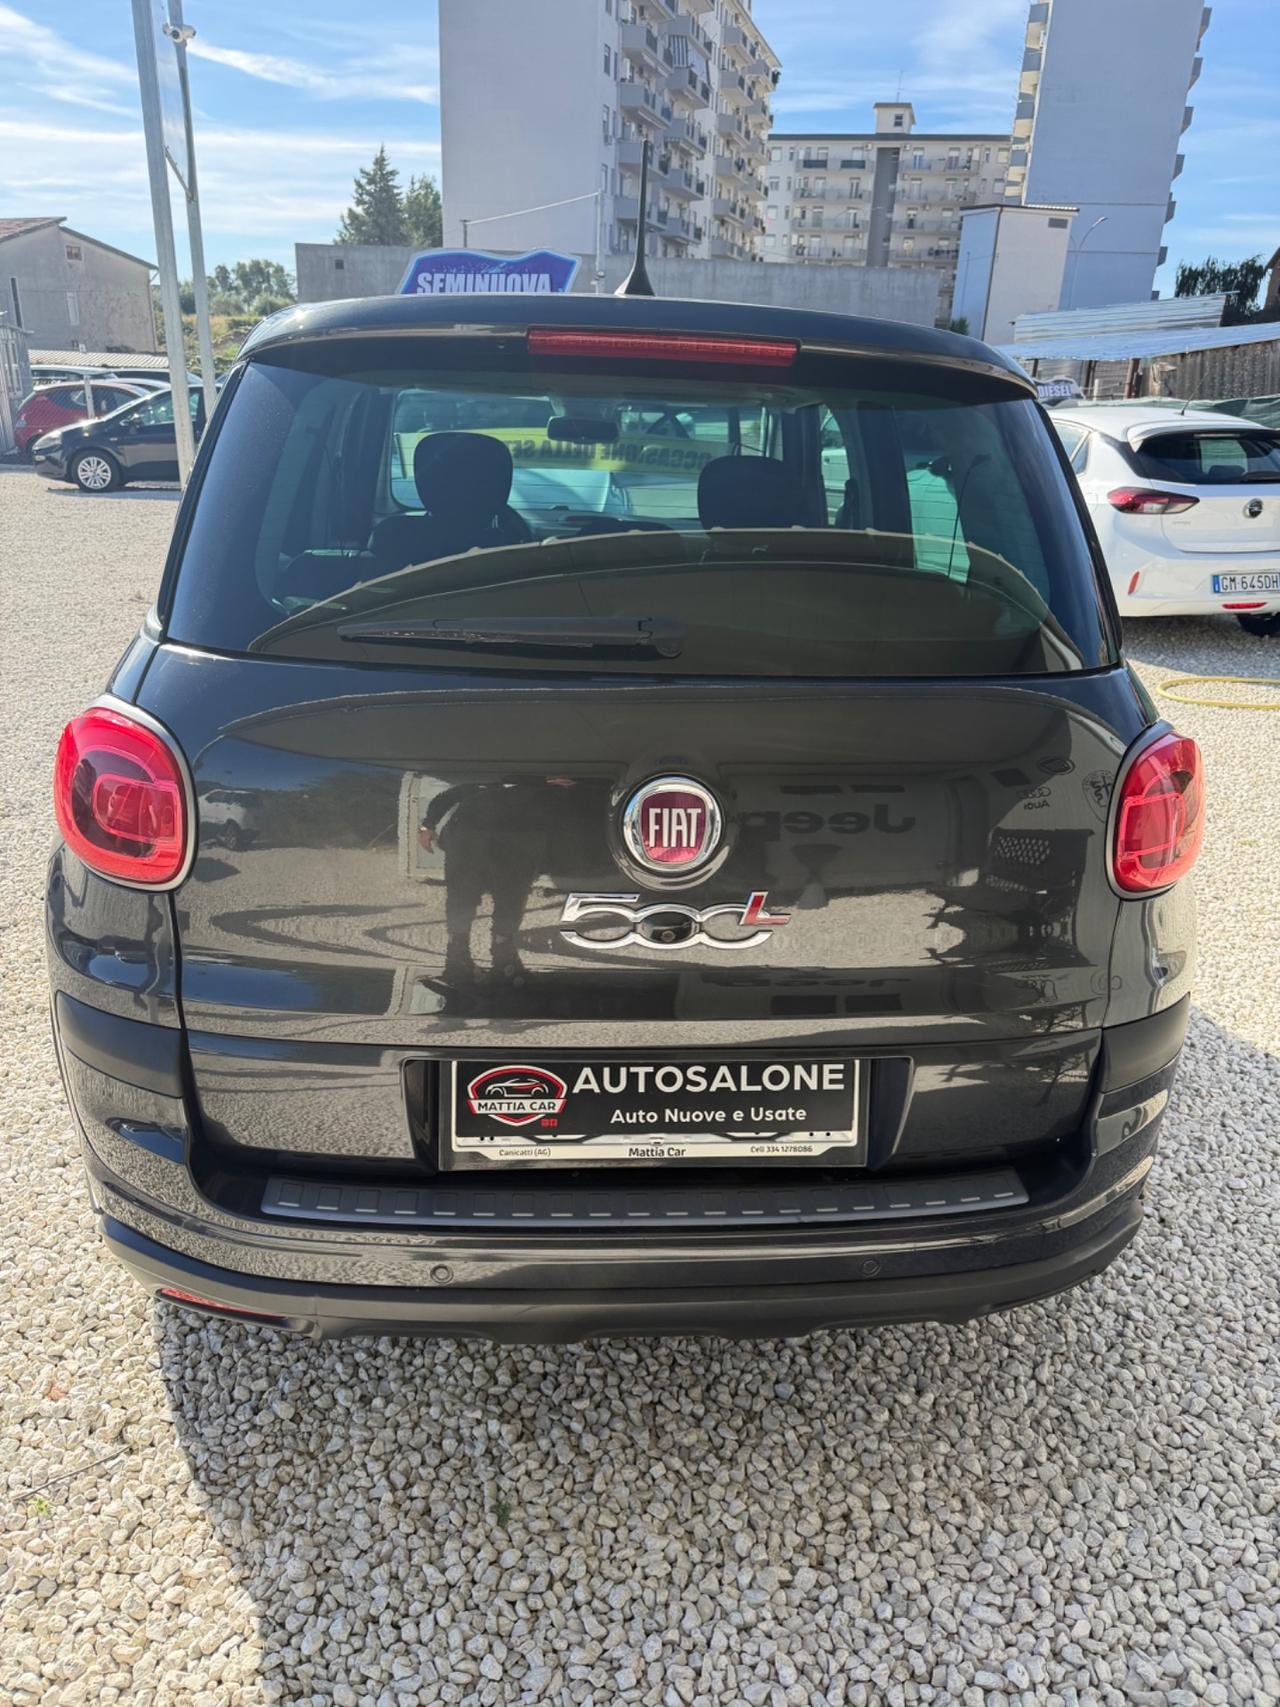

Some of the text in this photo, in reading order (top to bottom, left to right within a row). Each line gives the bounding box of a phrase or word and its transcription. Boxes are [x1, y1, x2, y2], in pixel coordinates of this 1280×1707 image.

[416, 272, 551, 294] SEMINUOVA
[1037, 384, 1072, 397] DIESEL
[1221, 575, 1279, 591] GM 645DH
[648, 807, 702, 849] FIAT
[572, 1064, 845, 1094] AUTOSALONE
[477, 1101, 556, 1112] MATTIA CAR
[610, 1107, 807, 1124] Auto Nuove e Usate
[534, 1147, 552, 1157] (AG)
[628, 1147, 686, 1157] Mattia Car
[750, 1145, 765, 1153] Cell
[766, 1145, 780, 1153] 334
